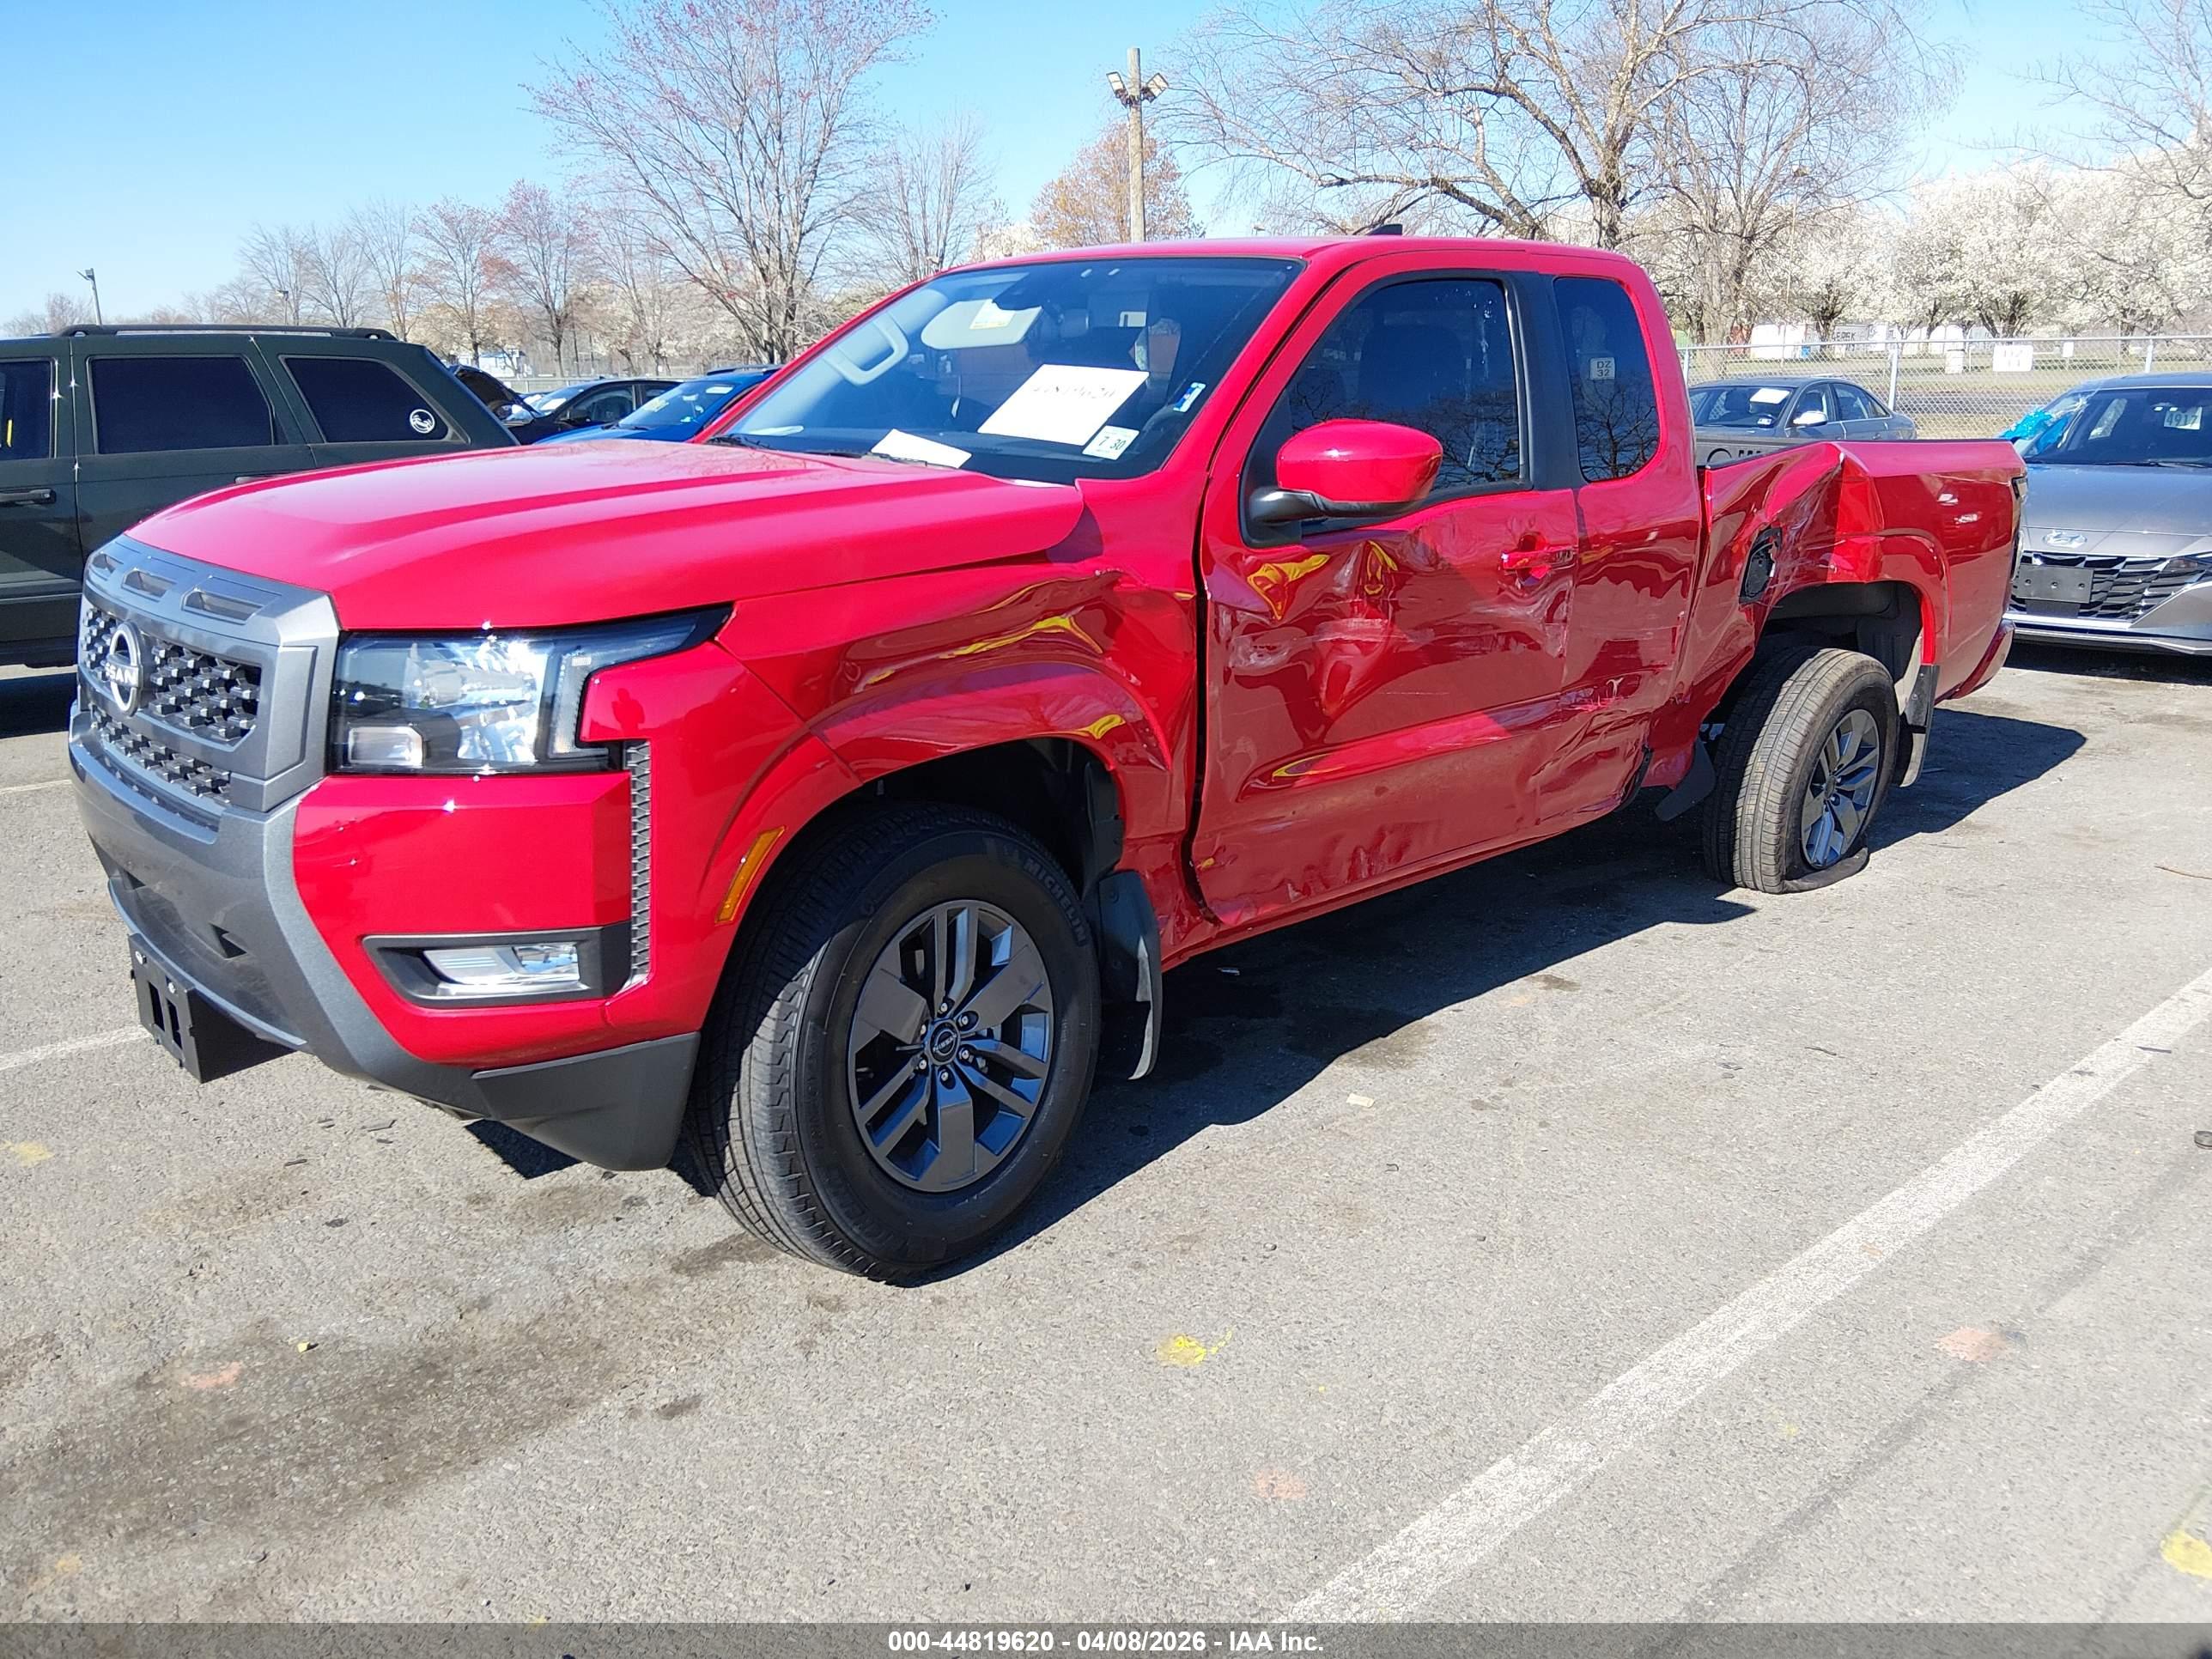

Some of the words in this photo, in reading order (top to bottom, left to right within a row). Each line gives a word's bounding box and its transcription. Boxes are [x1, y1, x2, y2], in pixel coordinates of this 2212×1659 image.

[1596, 360, 1612, 368] DZ
[1596, 368, 1610, 377] 32
[2166, 414, 2198, 427] 4917
[1098, 436, 1110, 447] 7
[1109, 439, 1127, 451] 30
[106, 662, 137, 684] SSAN
[1024, 858, 1086, 942] MICHELIN
[933, 1034, 957, 1052] NISSAN
